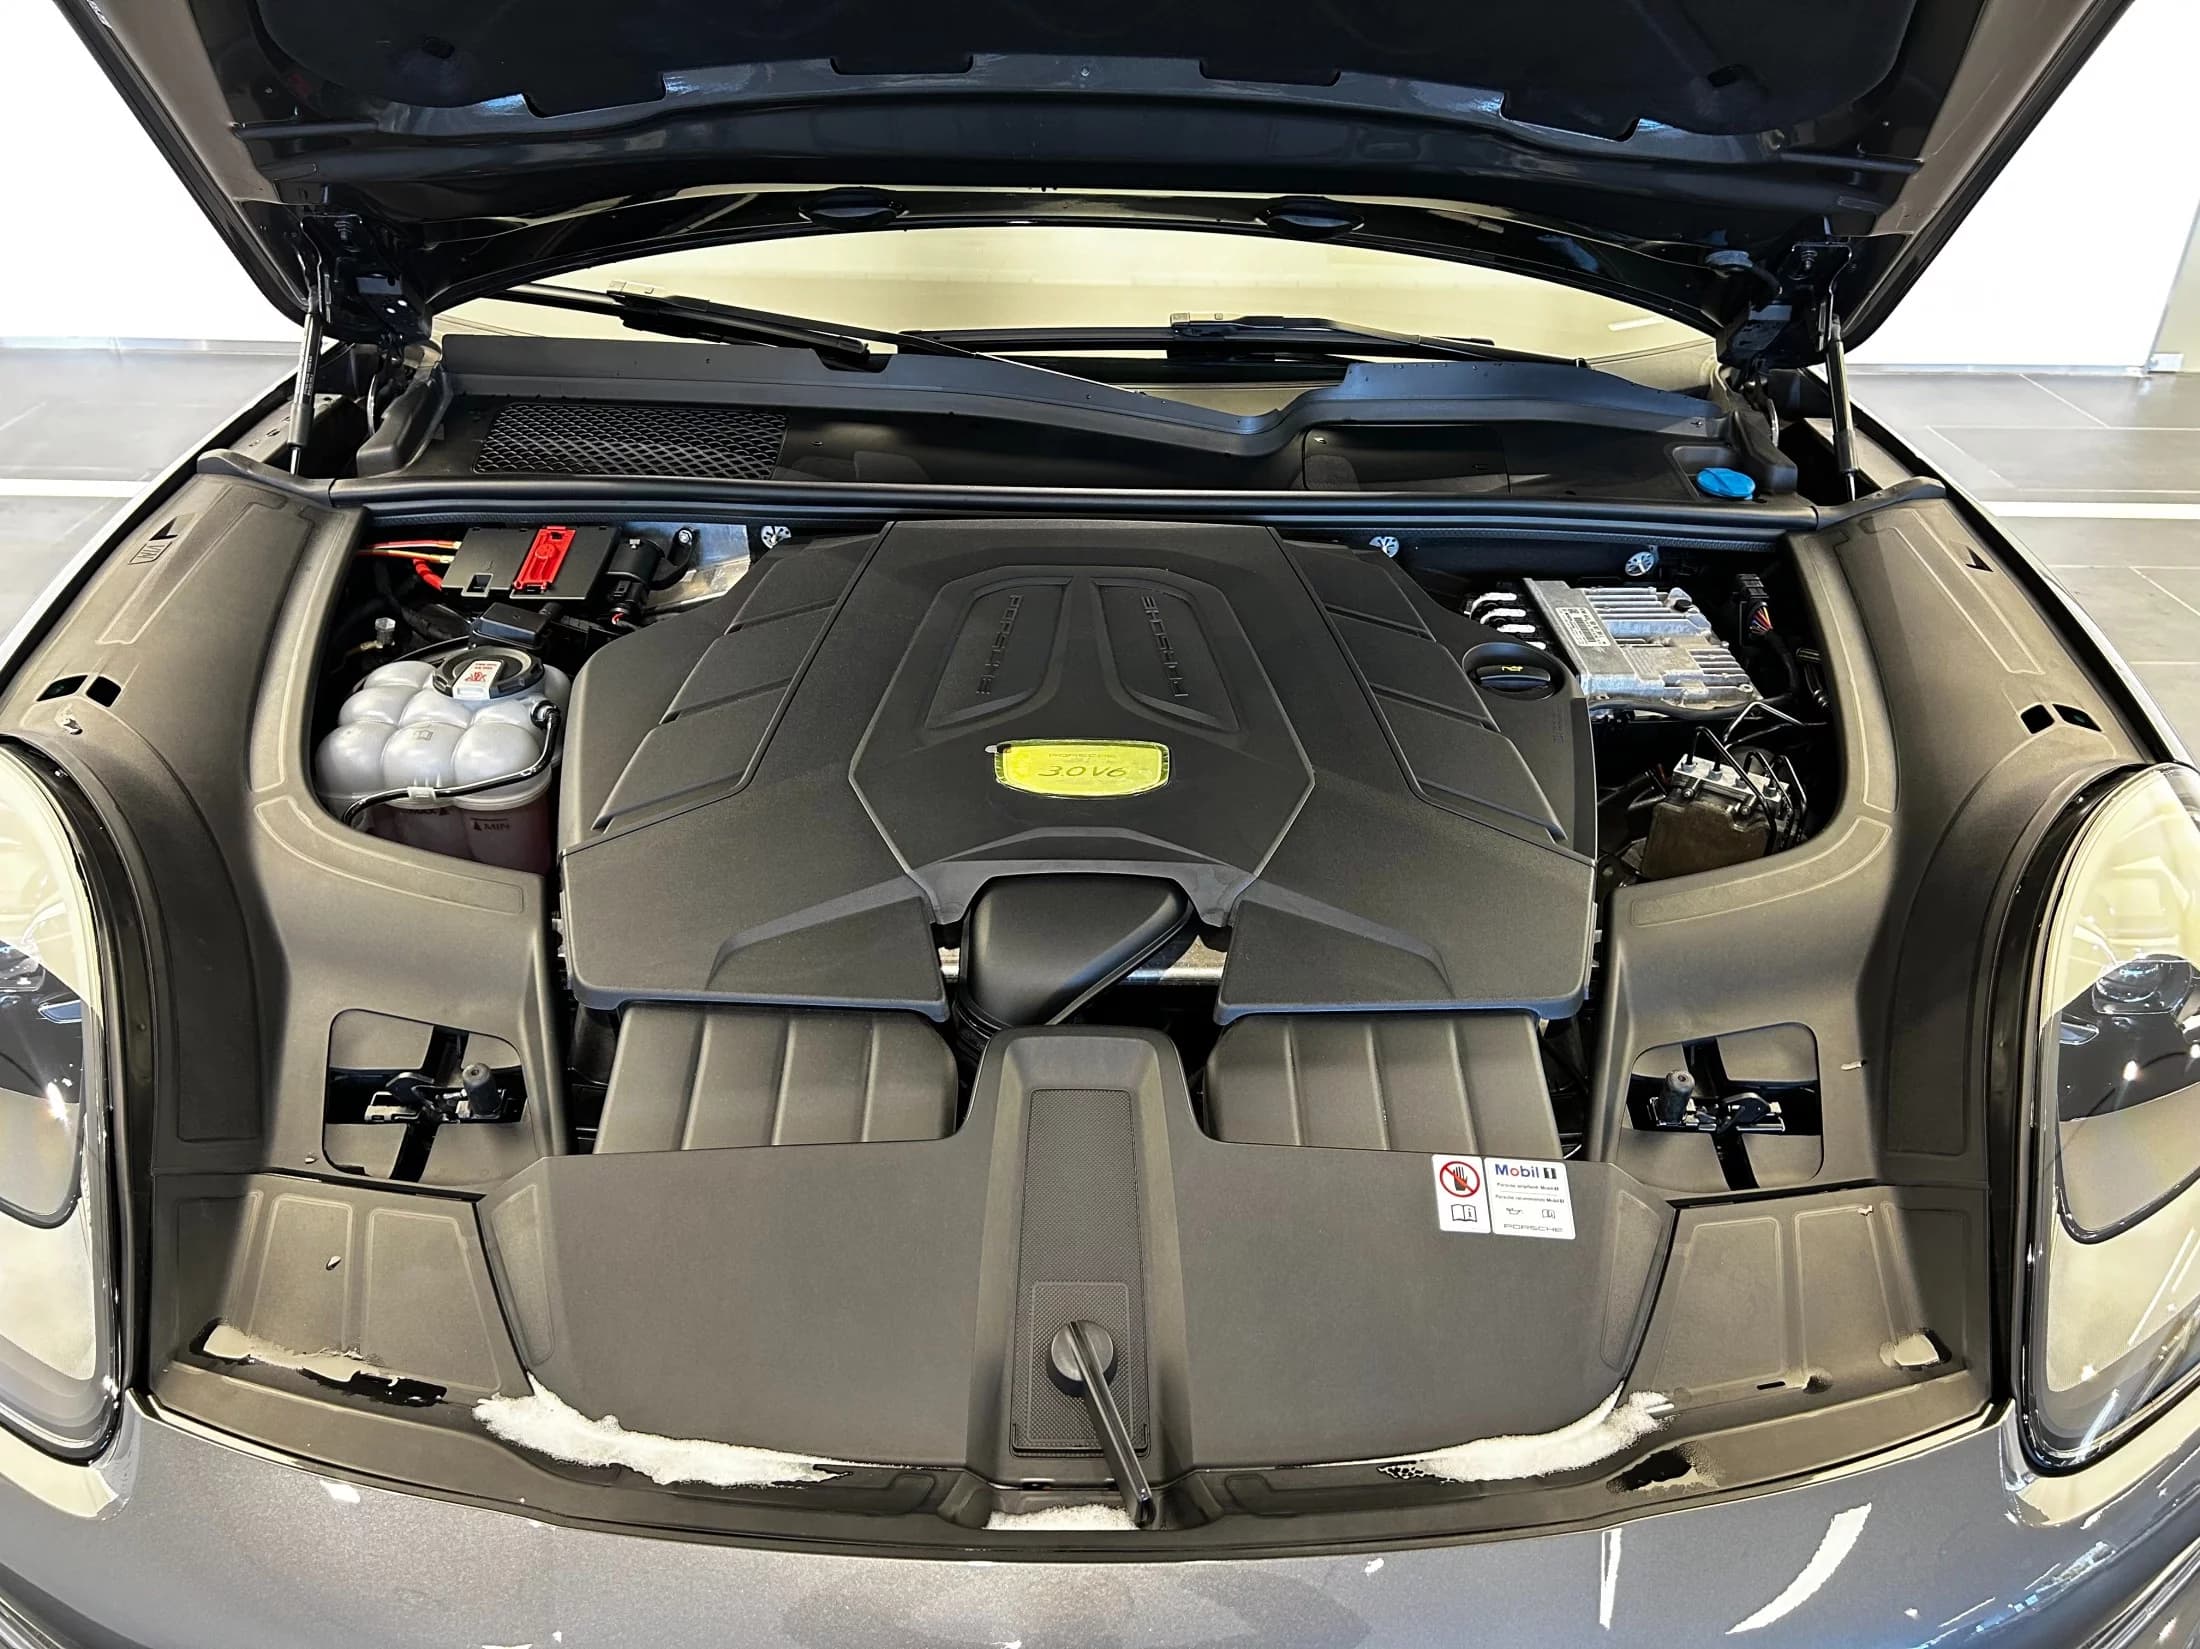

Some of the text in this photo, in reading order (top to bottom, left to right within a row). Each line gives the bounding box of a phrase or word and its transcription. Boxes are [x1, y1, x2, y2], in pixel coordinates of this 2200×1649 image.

[1038, 766, 1127, 777] 3.0 V6
[1495, 1163, 1540, 1178] Mobil
[1504, 1224, 1563, 1232] PORSCHE
